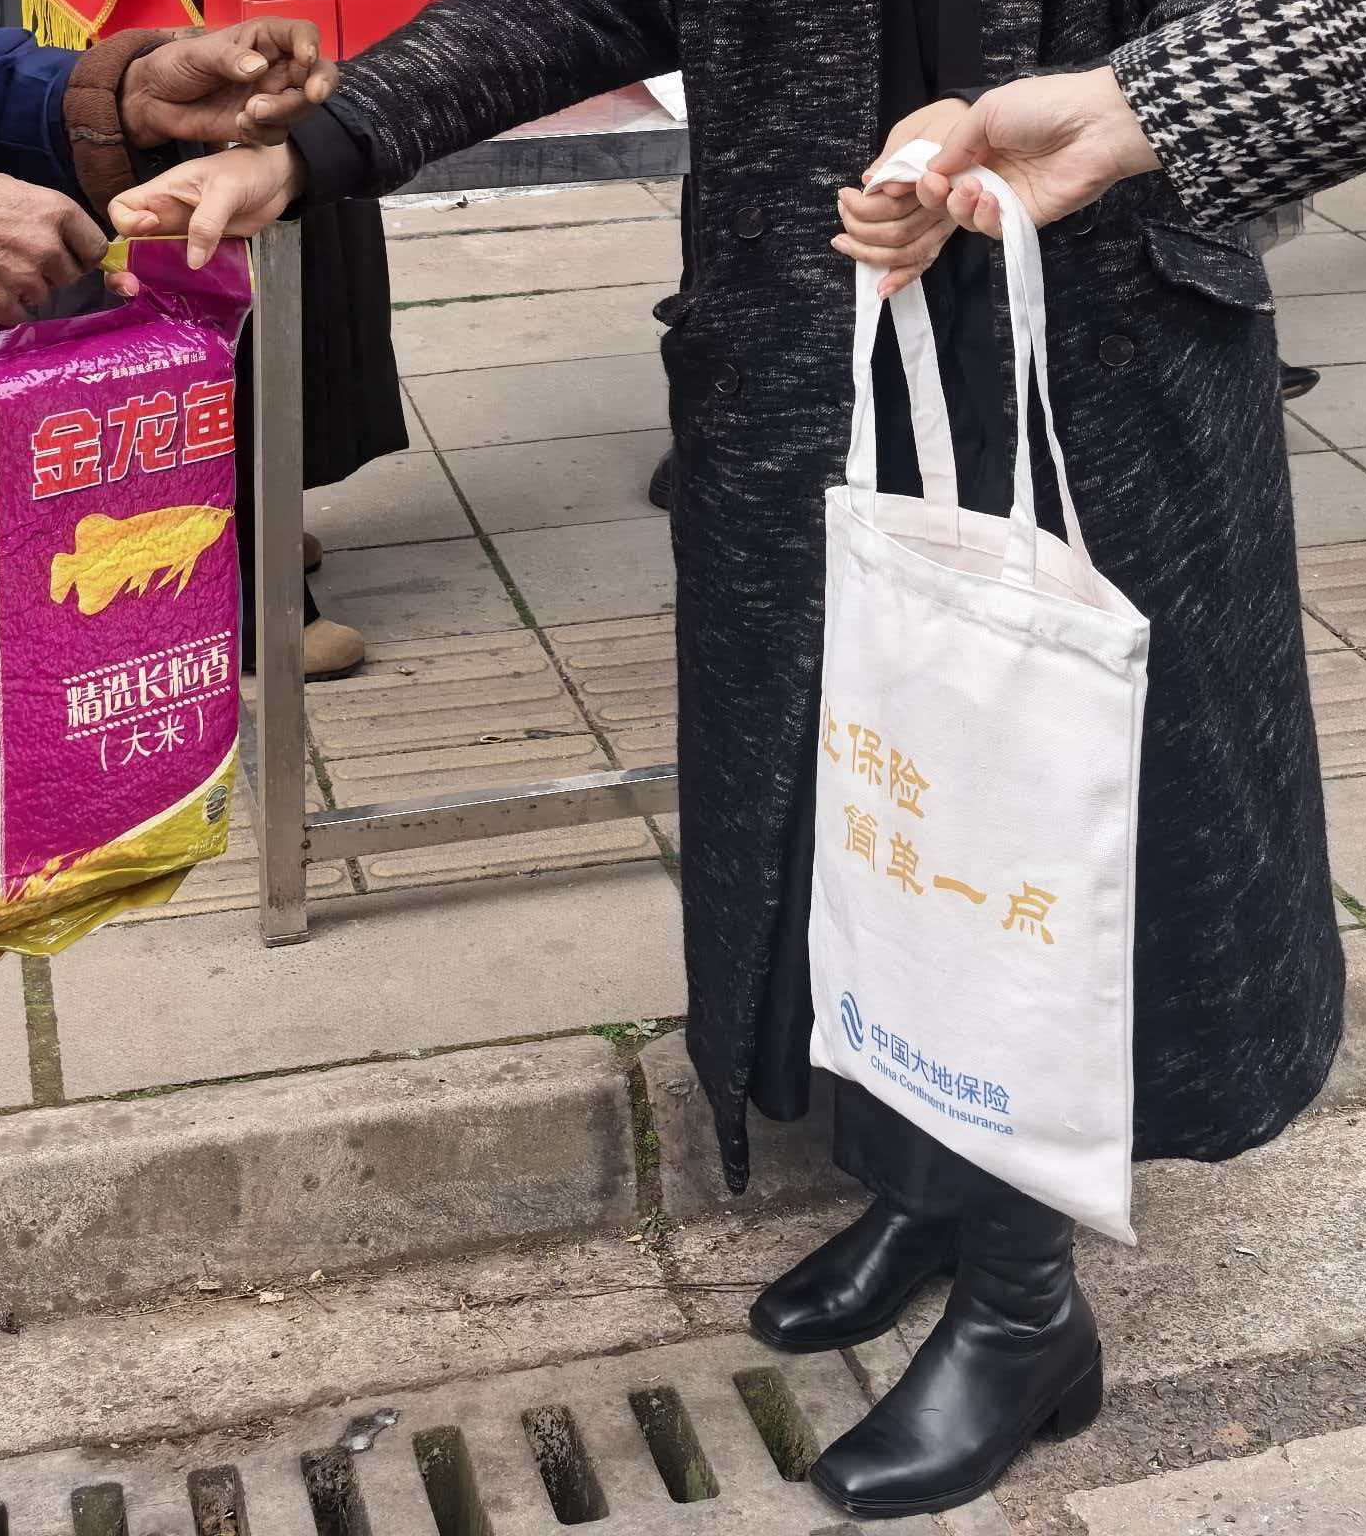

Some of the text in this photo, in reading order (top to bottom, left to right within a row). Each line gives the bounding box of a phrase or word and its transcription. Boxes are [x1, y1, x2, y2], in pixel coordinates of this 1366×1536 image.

[31, 379, 235, 500] 金龙鱼
[66, 641, 230, 728] 精选长粒香
[843, 803, 1057, 945] 简单一点
[870, 1055, 1014, 1135] China Continent Insurance
[871, 1023, 1011, 1115] 中国大地保险
